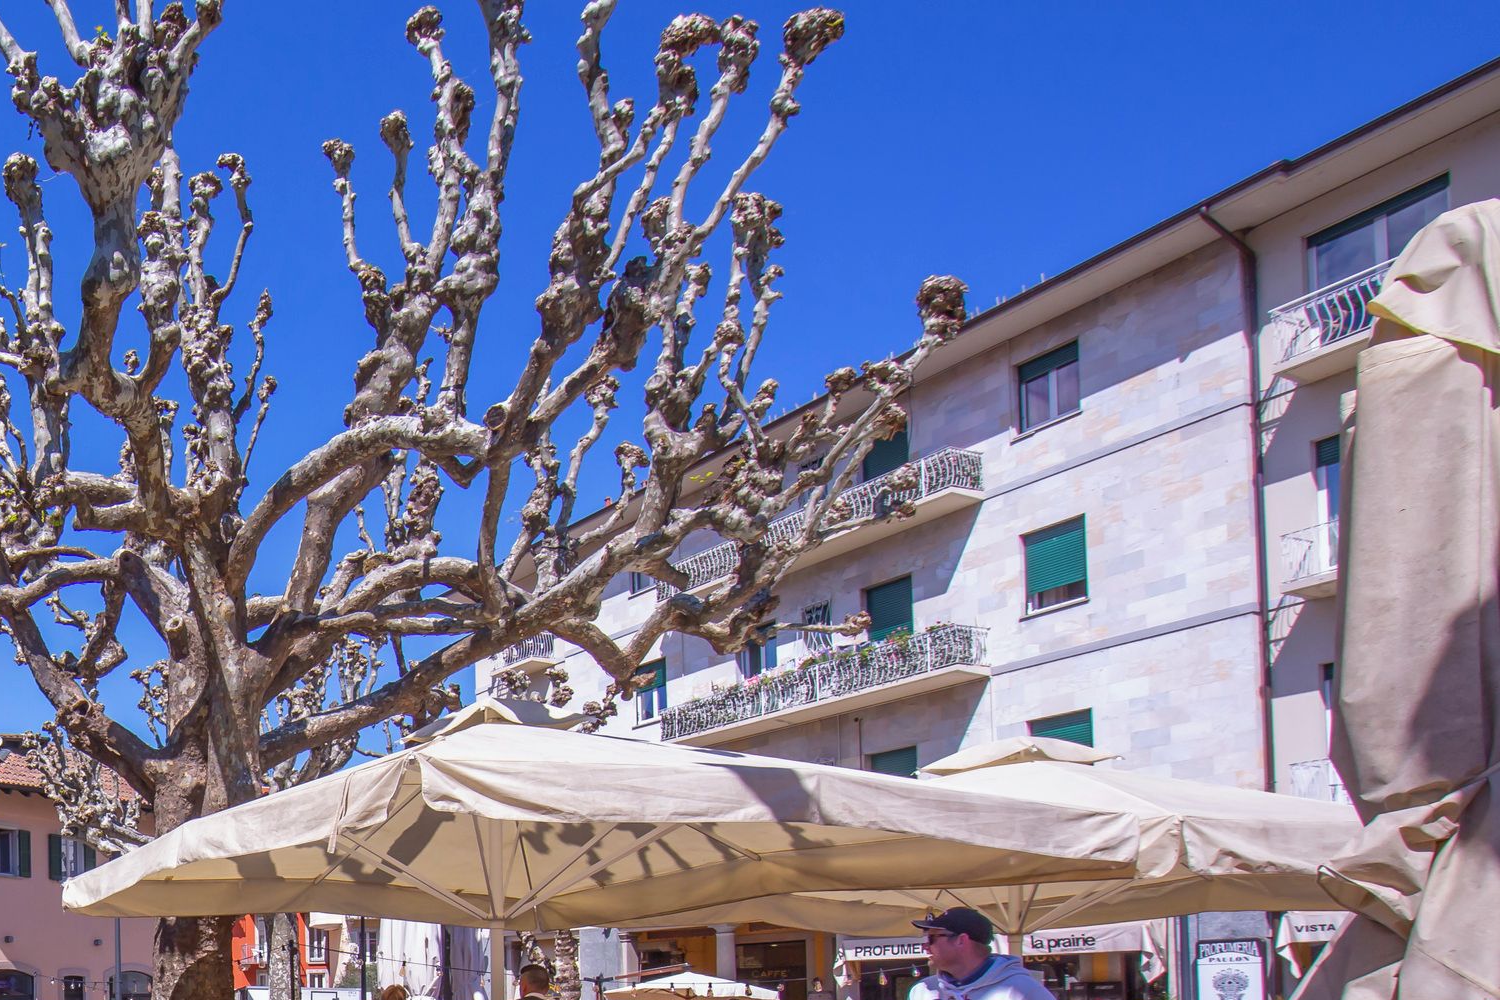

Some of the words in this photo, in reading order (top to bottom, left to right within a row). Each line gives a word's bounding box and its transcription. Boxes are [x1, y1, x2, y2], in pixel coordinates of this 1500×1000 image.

[1295, 923, 1336, 932] VISTA
[1030, 936, 1044, 949] la
[1047, 934, 1096, 953] prairie
[1199, 941, 1259, 958] PROFUMERIA
